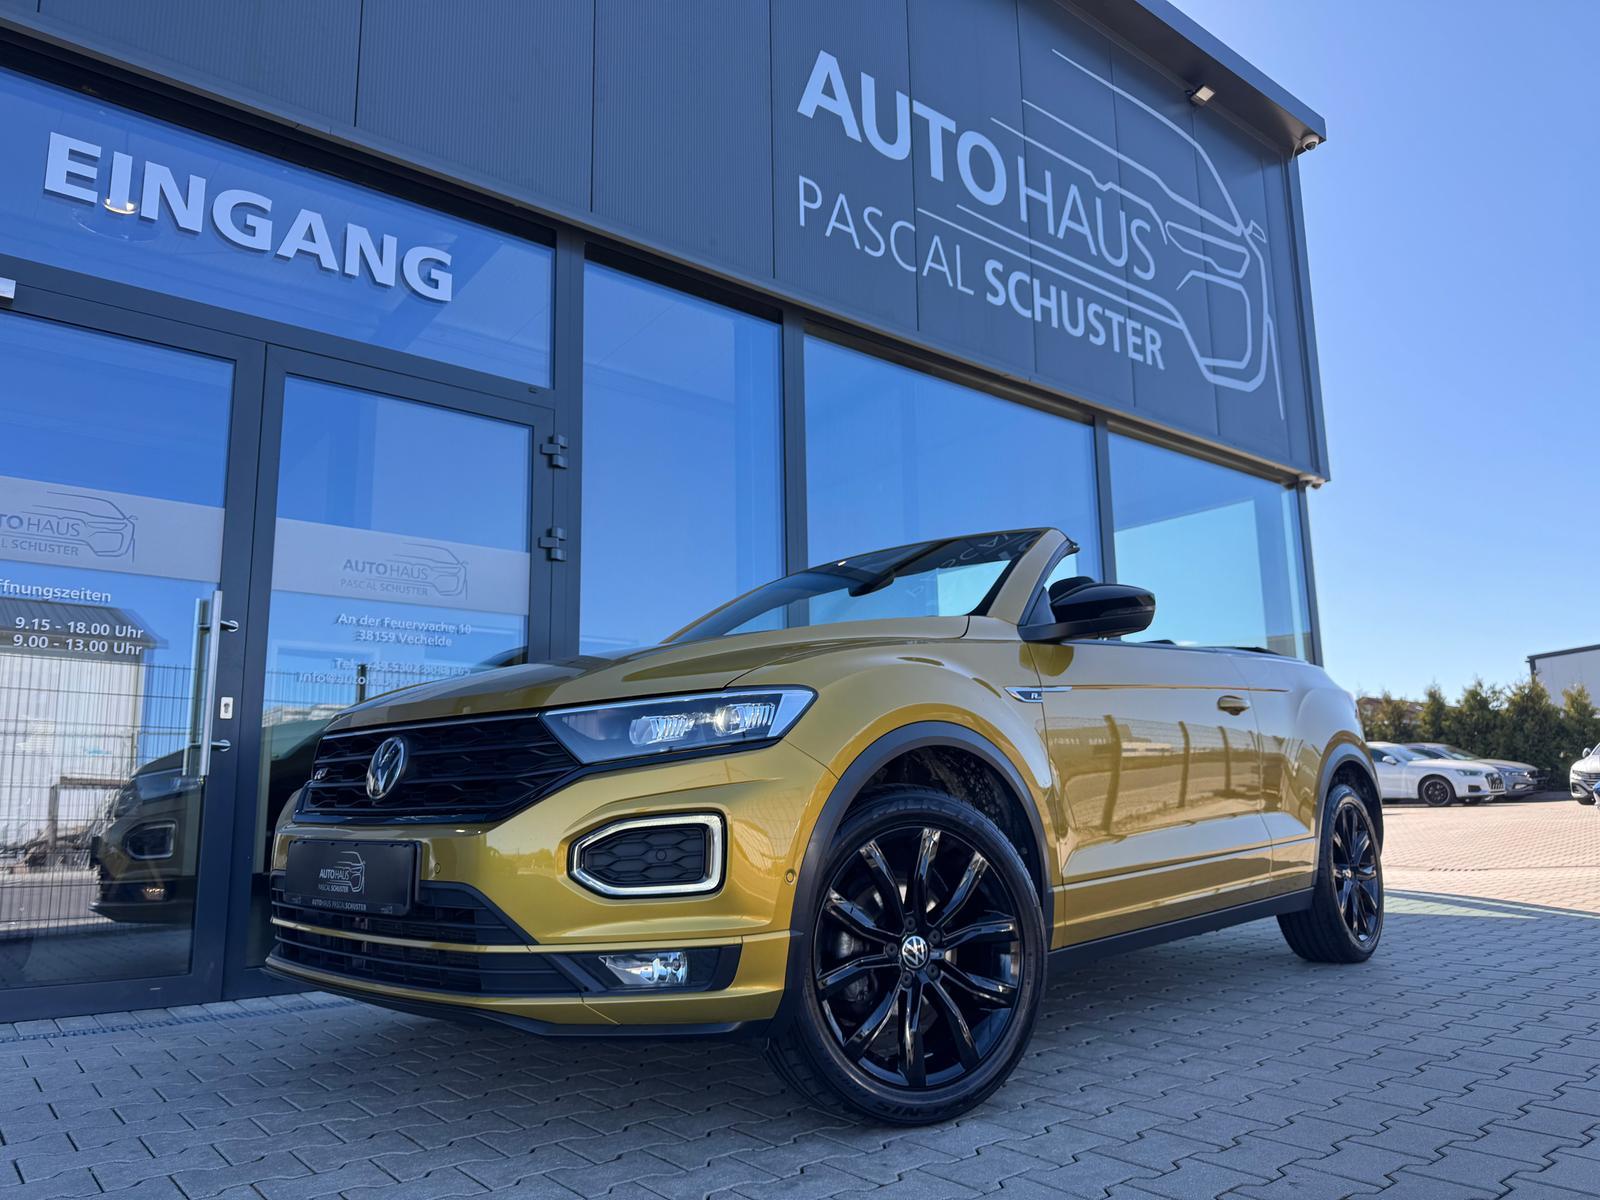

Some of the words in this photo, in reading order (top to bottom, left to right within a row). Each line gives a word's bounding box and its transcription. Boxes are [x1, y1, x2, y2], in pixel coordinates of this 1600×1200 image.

[44, 132, 453, 302] EINGANG
[798, 175, 975, 296] PASCAL
[985, 259, 1165, 371] SCHUSTER
[11, 539, 79, 557] SCHUSTER
[342, 559, 429, 581] AUTOHAUS
[340, 577, 377, 592] PASCAL
[380, 582, 429, 597] SCHUSTER
[15, 617, 50, 631] 9.15
[67, 621, 110, 636] 18.00
[115, 625, 144, 639] Uhr
[338, 613, 357, 625] An
[360, 614, 381, 626] der
[13, 634, 49, 649] 9.00
[66, 638, 108, 653] 13.00
[113, 642, 143, 655] Uhr
[358, 630, 395, 642] 38159
[398, 633, 452, 647] Vechelde
